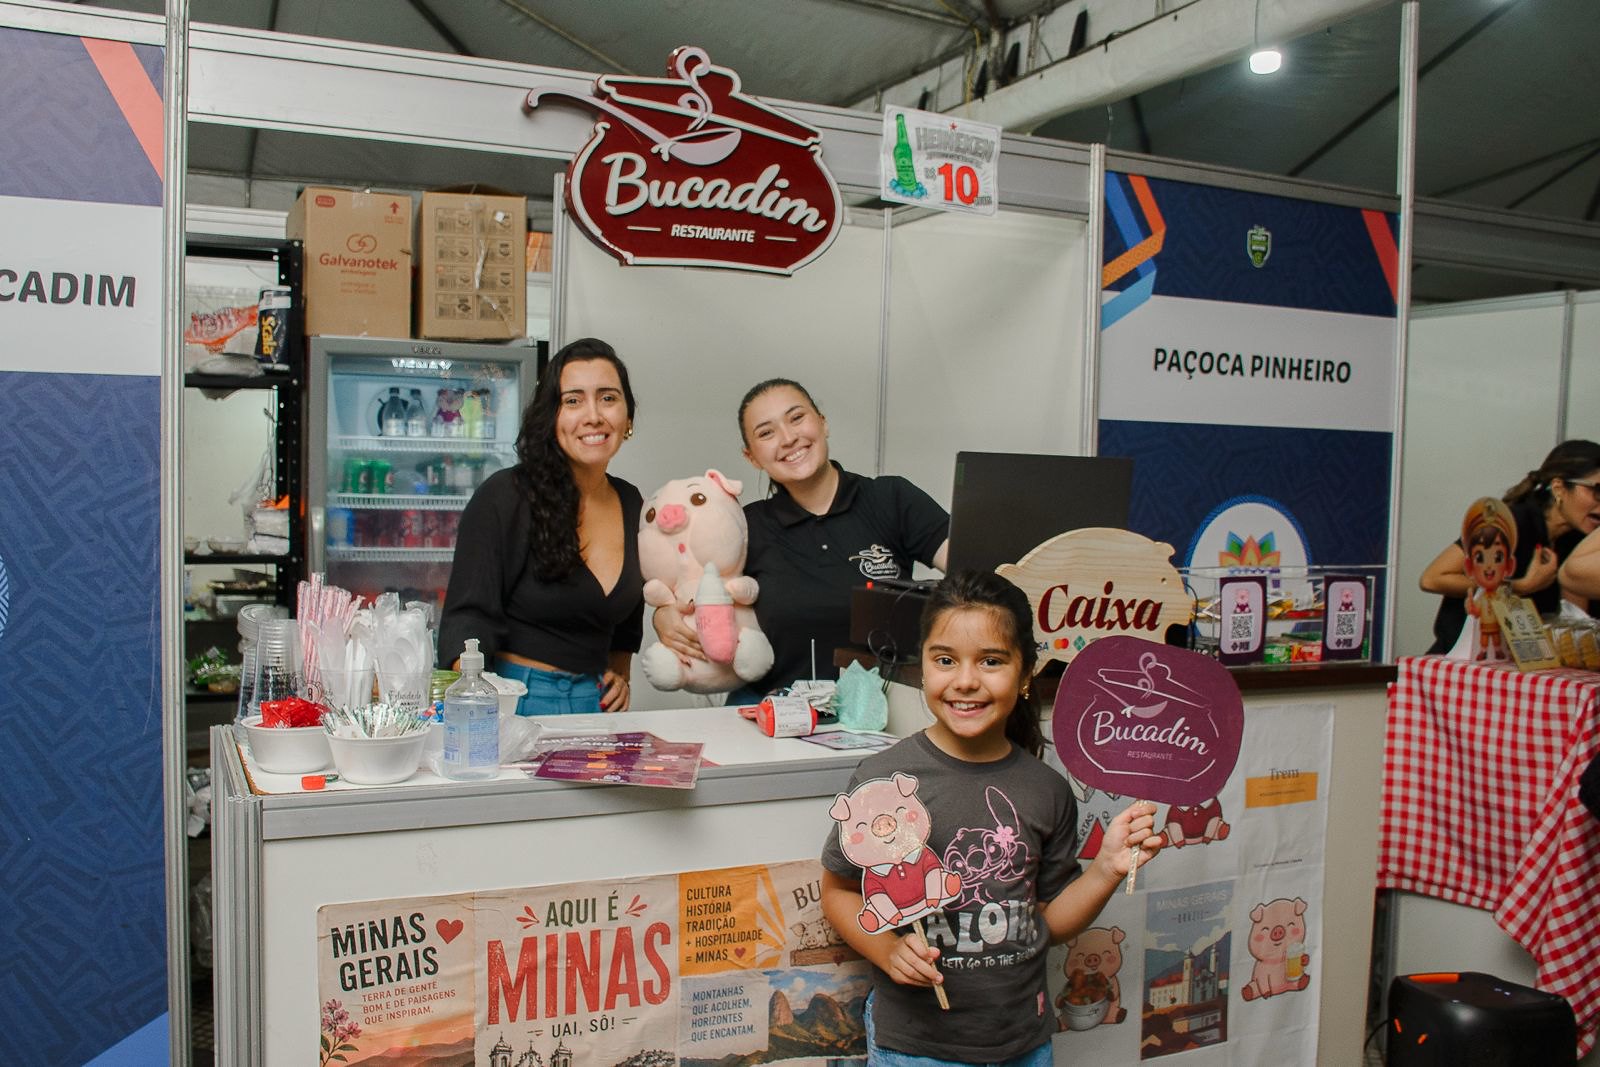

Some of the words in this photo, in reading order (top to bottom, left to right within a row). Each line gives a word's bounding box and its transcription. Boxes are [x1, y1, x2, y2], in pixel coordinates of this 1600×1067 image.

[601, 151, 827, 232] Bucadim
[937, 162, 979, 205] 10
[671, 224, 756, 243] RESTAURANTE
[319, 252, 398, 271] Galvanotek
[1153, 348, 1245, 380] PAÇOCA
[1251, 354, 1351, 384] PINHEIRO
[1038, 580, 1163, 634] Caixa
[1093, 710, 1209, 756] Bucadim
[1127, 750, 1173, 761] RESTAURANTE
[686, 885, 732, 901] CULTURA
[545, 898, 597, 928] AQUI
[607, 890, 619, 921] É
[686, 914, 736, 933] TRADIÇÃO
[330, 912, 427, 959] MINAS
[695, 929, 763, 948] HOSPITALIDADE
[695, 949, 728, 964] MINAS
[966, 956, 980, 970] GO
[982, 956, 996, 968] TO
[998, 954, 1014, 967] THE
[339, 946, 439, 992] GERAIS
[487, 921, 671, 1026] MINAS
[362, 990, 391, 1003] TERRA
[395, 987, 408, 997] DE
[409, 981, 438, 994] GENTE
[363, 1003, 383, 1014] BOM
[386, 1002, 391, 1011] E
[394, 999, 405, 1008] DE
[408, 989, 456, 1005] PAISAGENS
[692, 985, 744, 1001] MONTANHAS
[364, 1014, 383, 1025] QUE
[386, 1006, 434, 1021] INSPIRAM.
[692, 1003, 709, 1015] QUE
[551, 1022, 583, 1038] UAI,
[589, 1014, 615, 1032] SÔ!
[691, 1012, 743, 1028] HORIZONTES
[691, 1030, 708, 1042] QUE
[710, 1024, 756, 1039] ENCANTAM.
